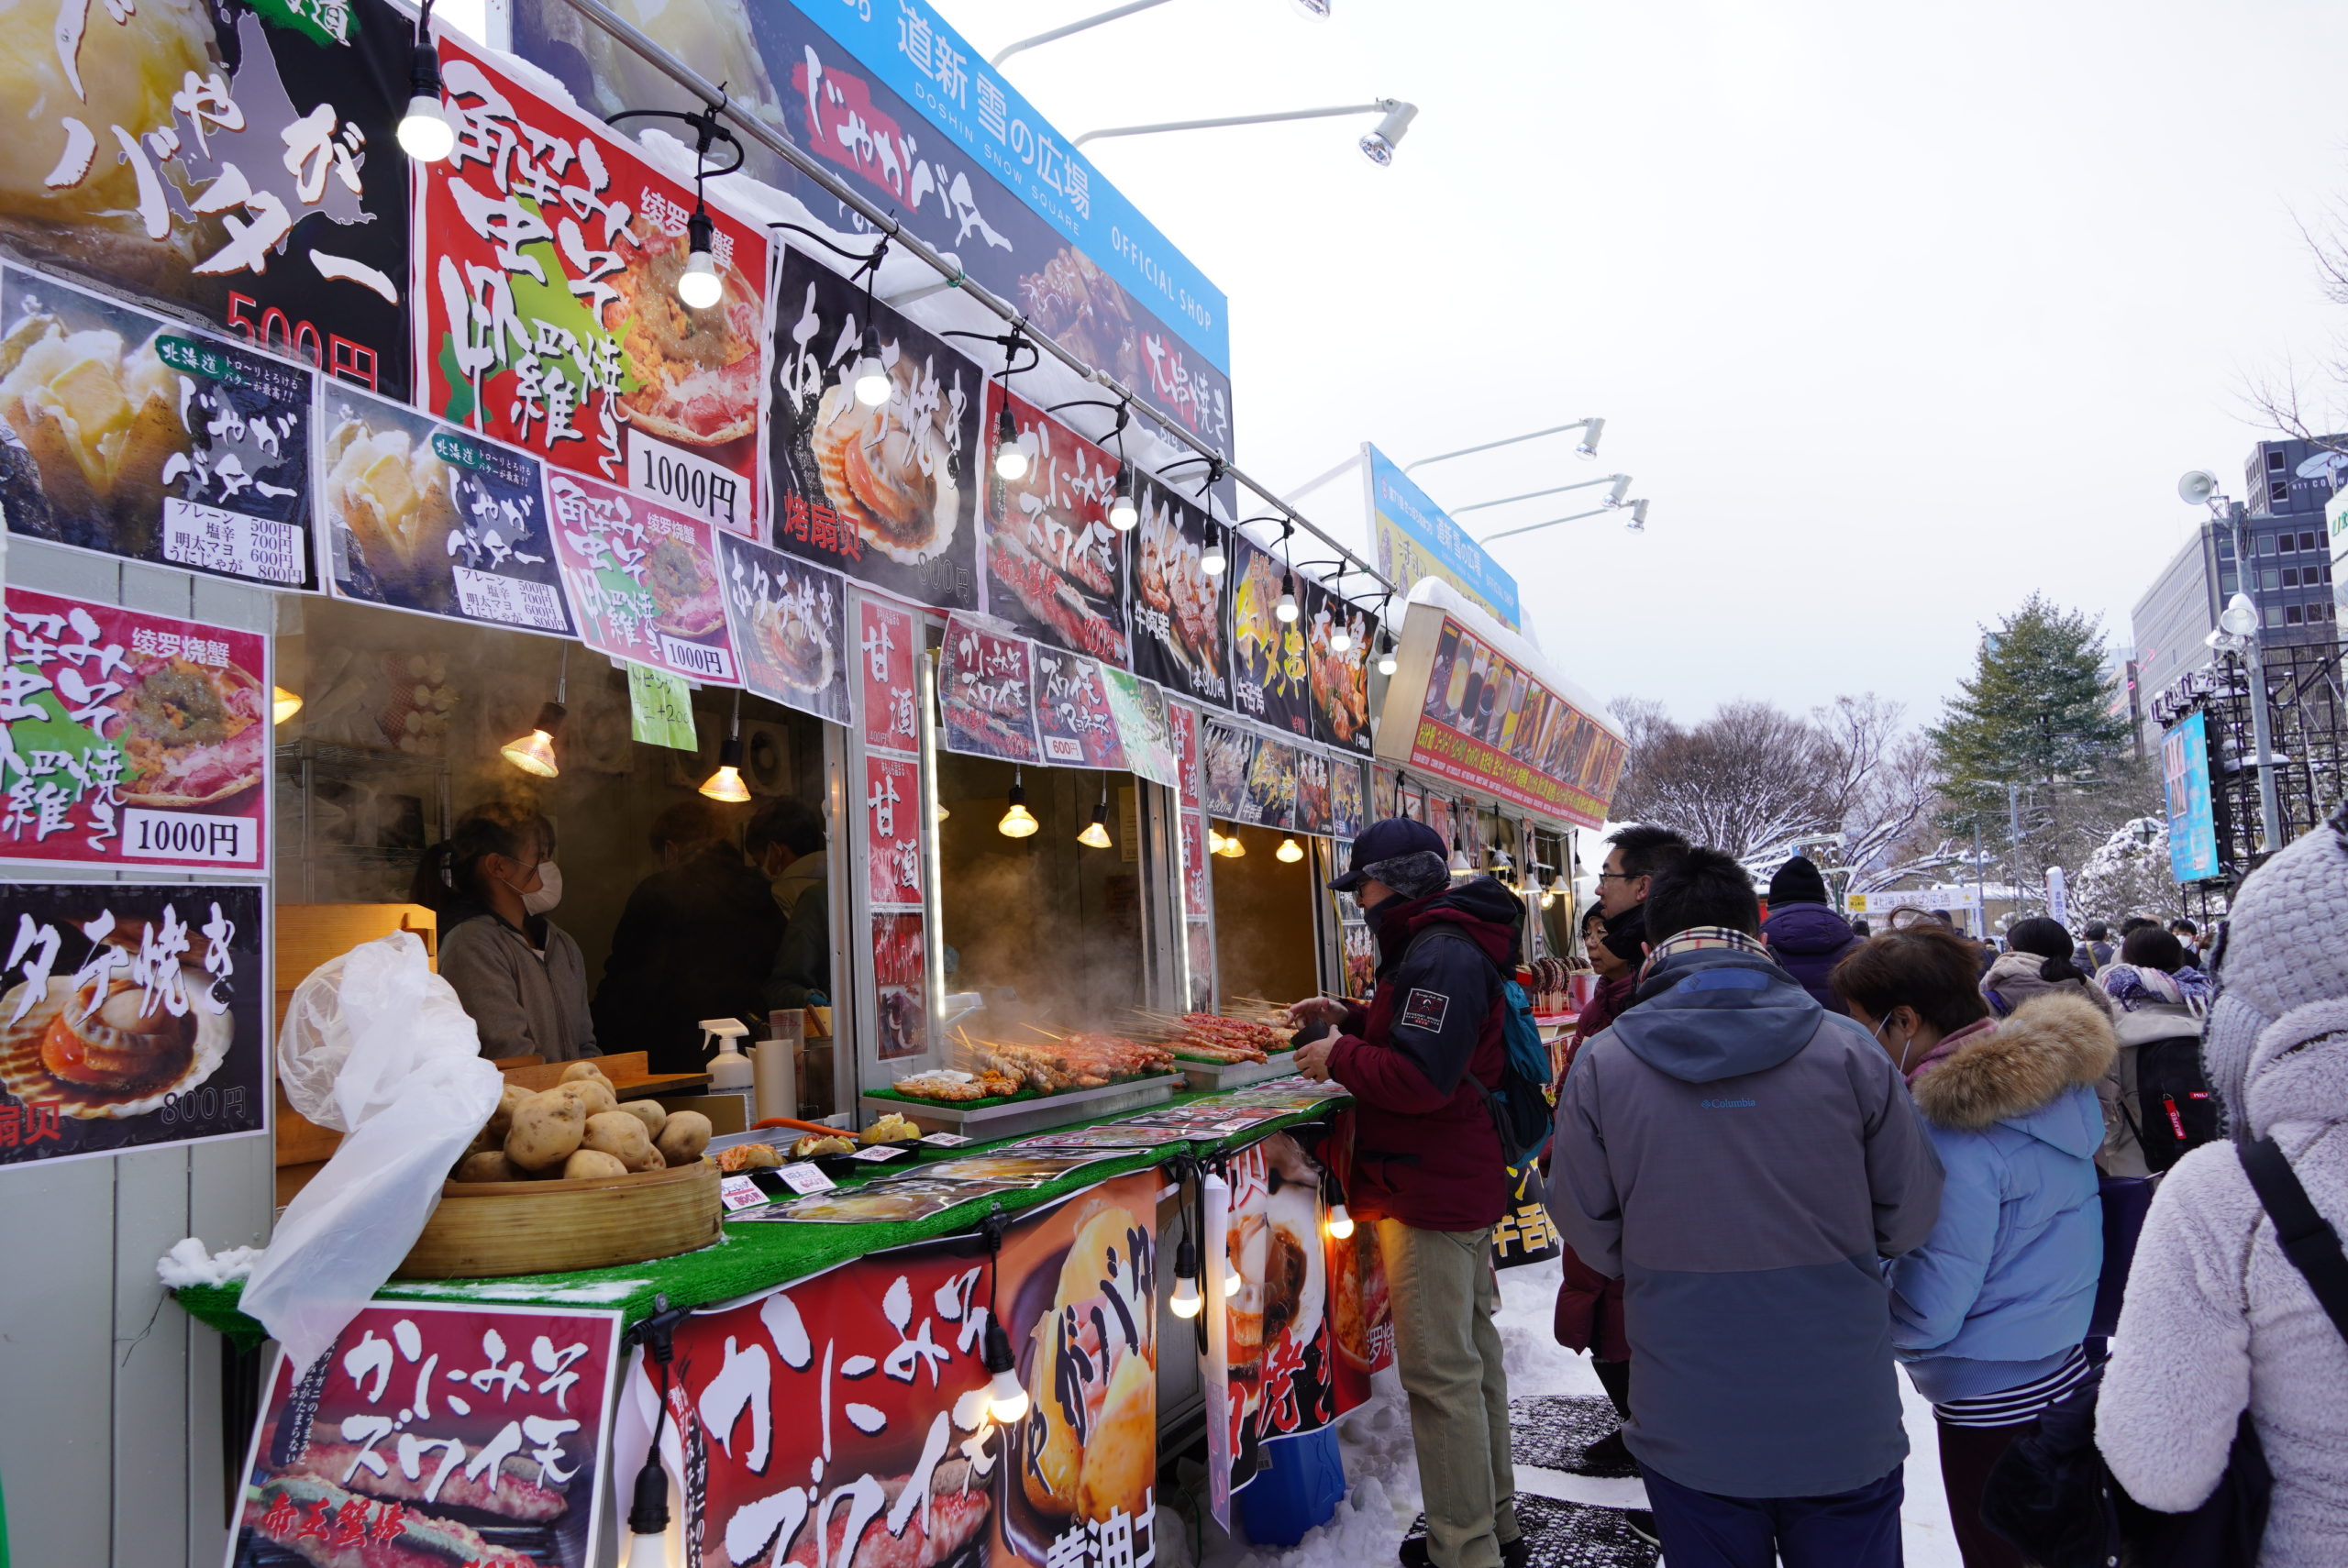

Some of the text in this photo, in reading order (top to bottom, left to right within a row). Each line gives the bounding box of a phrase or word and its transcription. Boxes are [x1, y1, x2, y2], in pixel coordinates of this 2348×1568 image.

[897, 0, 969, 111] 道新
[976, 72, 1091, 221] 雪の広場
[915, 82, 1080, 237] DOSHIN SNOW SQUARE
[45, 116, 399, 305] バター
[640, 186, 735, 271] 绫罗蟹
[1111, 225, 1212, 332] OFFICIAL SHOP
[161, 340, 220, 375] 北海道
[178, 374, 298, 458] じゃが
[436, 437, 475, 465] 北海道
[1016, 420, 1117, 524] かにみそ
[162, 451, 298, 504] バター
[448, 465, 534, 532] じゃが
[643, 448, 737, 524] 1000円
[2292, 477, 2345, 491] NTT COW
[177, 502, 293, 539] プレーン 500円
[205, 522, 294, 555] 塩辛 700円
[783, 488, 861, 562] 烤扇贝
[170, 546, 303, 584] うにじゃが 800円
[174, 531, 294, 569] 明太マヨ 600円
[447, 528, 546, 569] バター
[461, 569, 550, 597] プレーン 500円
[521, 591, 553, 608] 700円
[731, 547, 834, 650] ホタテ焼き
[917, 551, 970, 602] 800円
[525, 603, 558, 620] 600円
[532, 615, 566, 631] 800円
[131, 626, 230, 669] 绫罗烧蟹
[670, 643, 722, 675] 1000円
[958, 631, 1023, 678] かにみそ
[861, 622, 916, 740] 甘酒
[1052, 739, 1080, 756] 600円
[138, 819, 239, 858] 1000円
[868, 774, 919, 891] 甘酒
[0, 901, 236, 1028] タテ焼き
[161, 1085, 247, 1125] 800円
[1711, 1097, 1757, 1109] Columbia
[344, 1318, 591, 1414] かにみそ
[698, 1265, 991, 1477] かにみそ
[295, 1337, 338, 1466] ワイガニのうまみと
[262, 1491, 410, 1550] 帝王蟹棒
